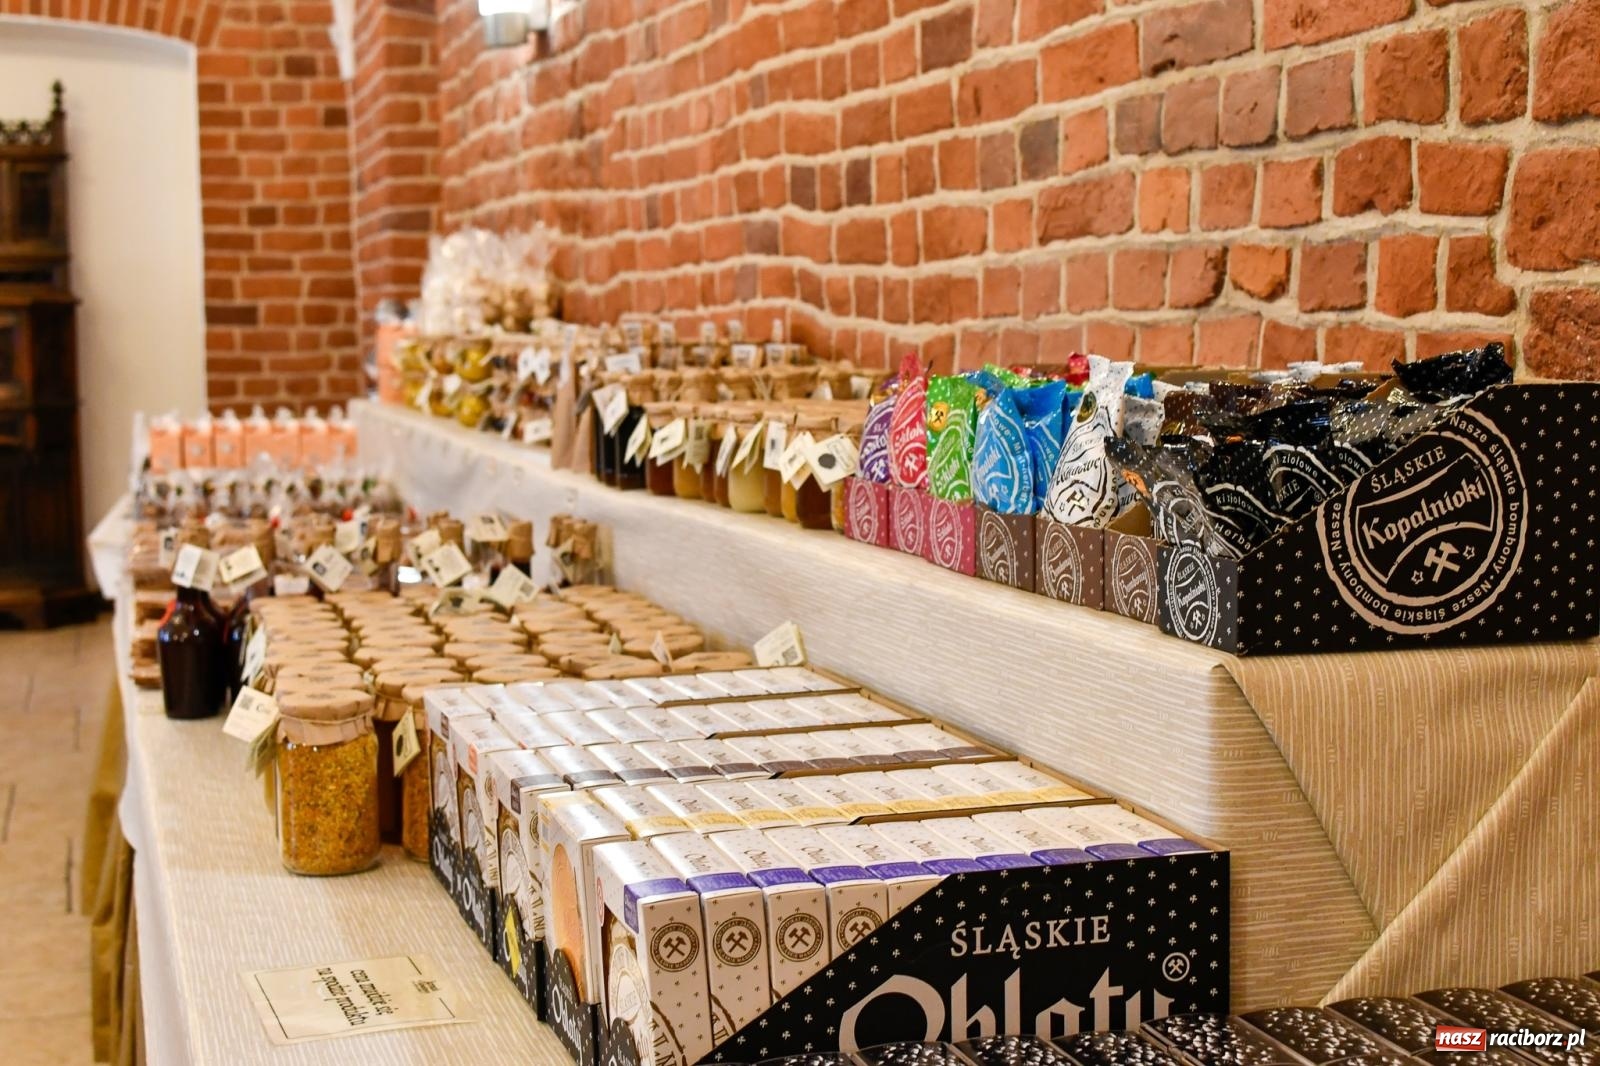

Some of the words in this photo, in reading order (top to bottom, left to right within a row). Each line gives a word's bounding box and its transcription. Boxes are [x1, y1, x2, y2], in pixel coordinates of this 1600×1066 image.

[1450, 414, 1487, 443] Nasze
[1371, 445, 1448, 494] ŚLĄSKIE
[1489, 443, 1516, 495] śląskie
[1331, 503, 1342, 551] Nasze
[1361, 476, 1486, 549] Kopalnioki
[1493, 501, 1521, 574] bombony
[1341, 560, 1390, 617] bombony
[1452, 580, 1492, 613] Nasze
[1394, 606, 1447, 623] śląskie
[950, 915, 1112, 960] ŚLĄSKIE
